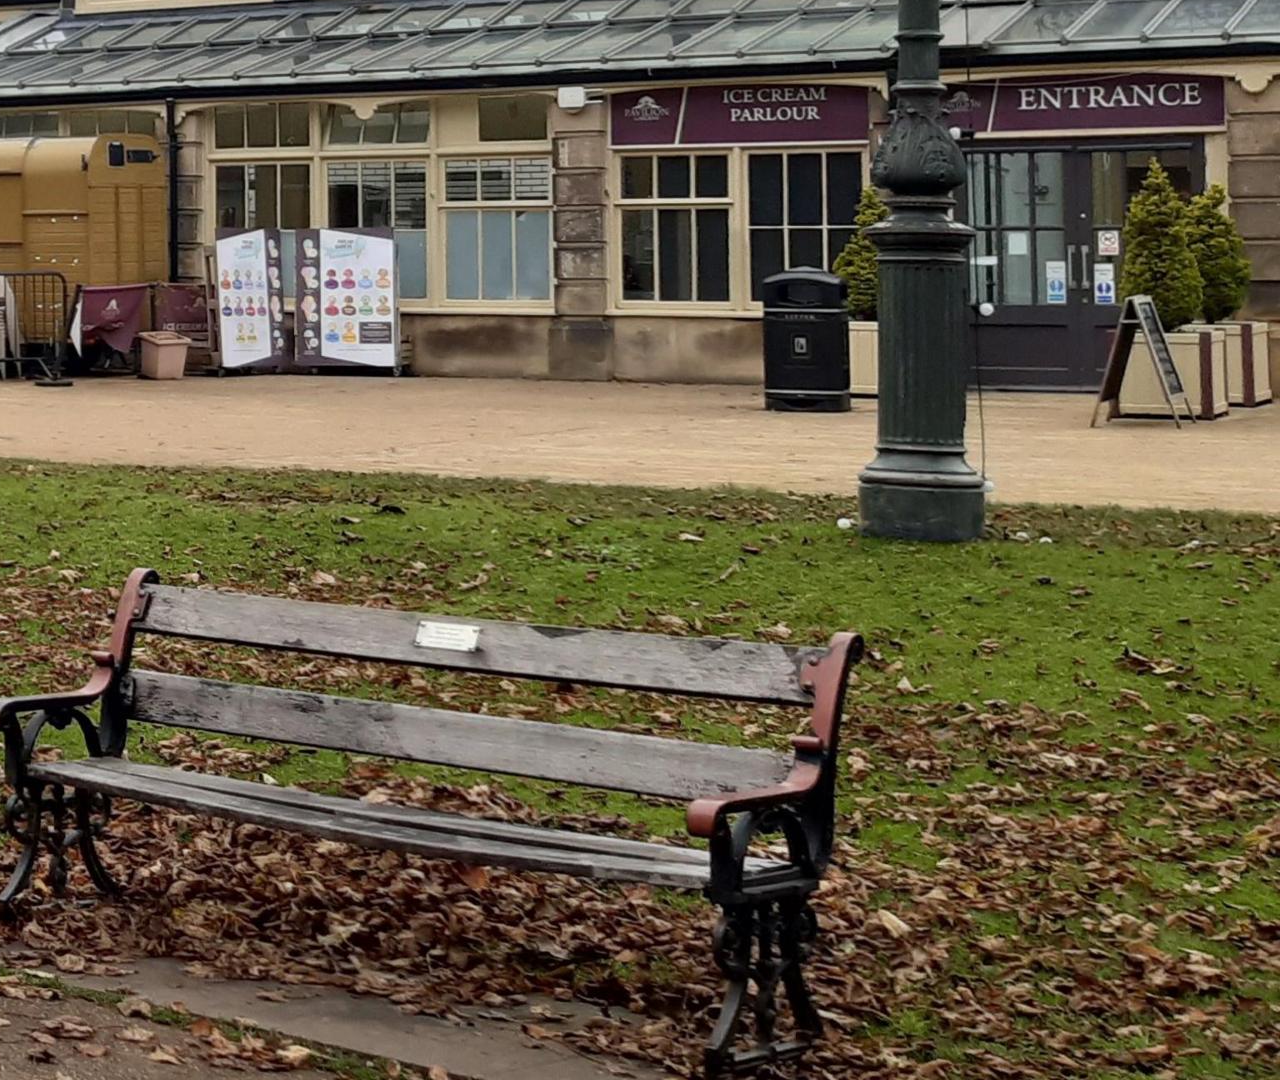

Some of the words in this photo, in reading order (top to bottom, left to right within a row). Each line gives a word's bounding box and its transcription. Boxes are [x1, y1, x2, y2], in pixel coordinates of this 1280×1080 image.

[723, 89, 754, 103] ICE
[757, 87, 827, 102] CREAM
[1017, 83, 1202, 110] ENTRANCE
[730, 106, 821, 121] PARLOUR
